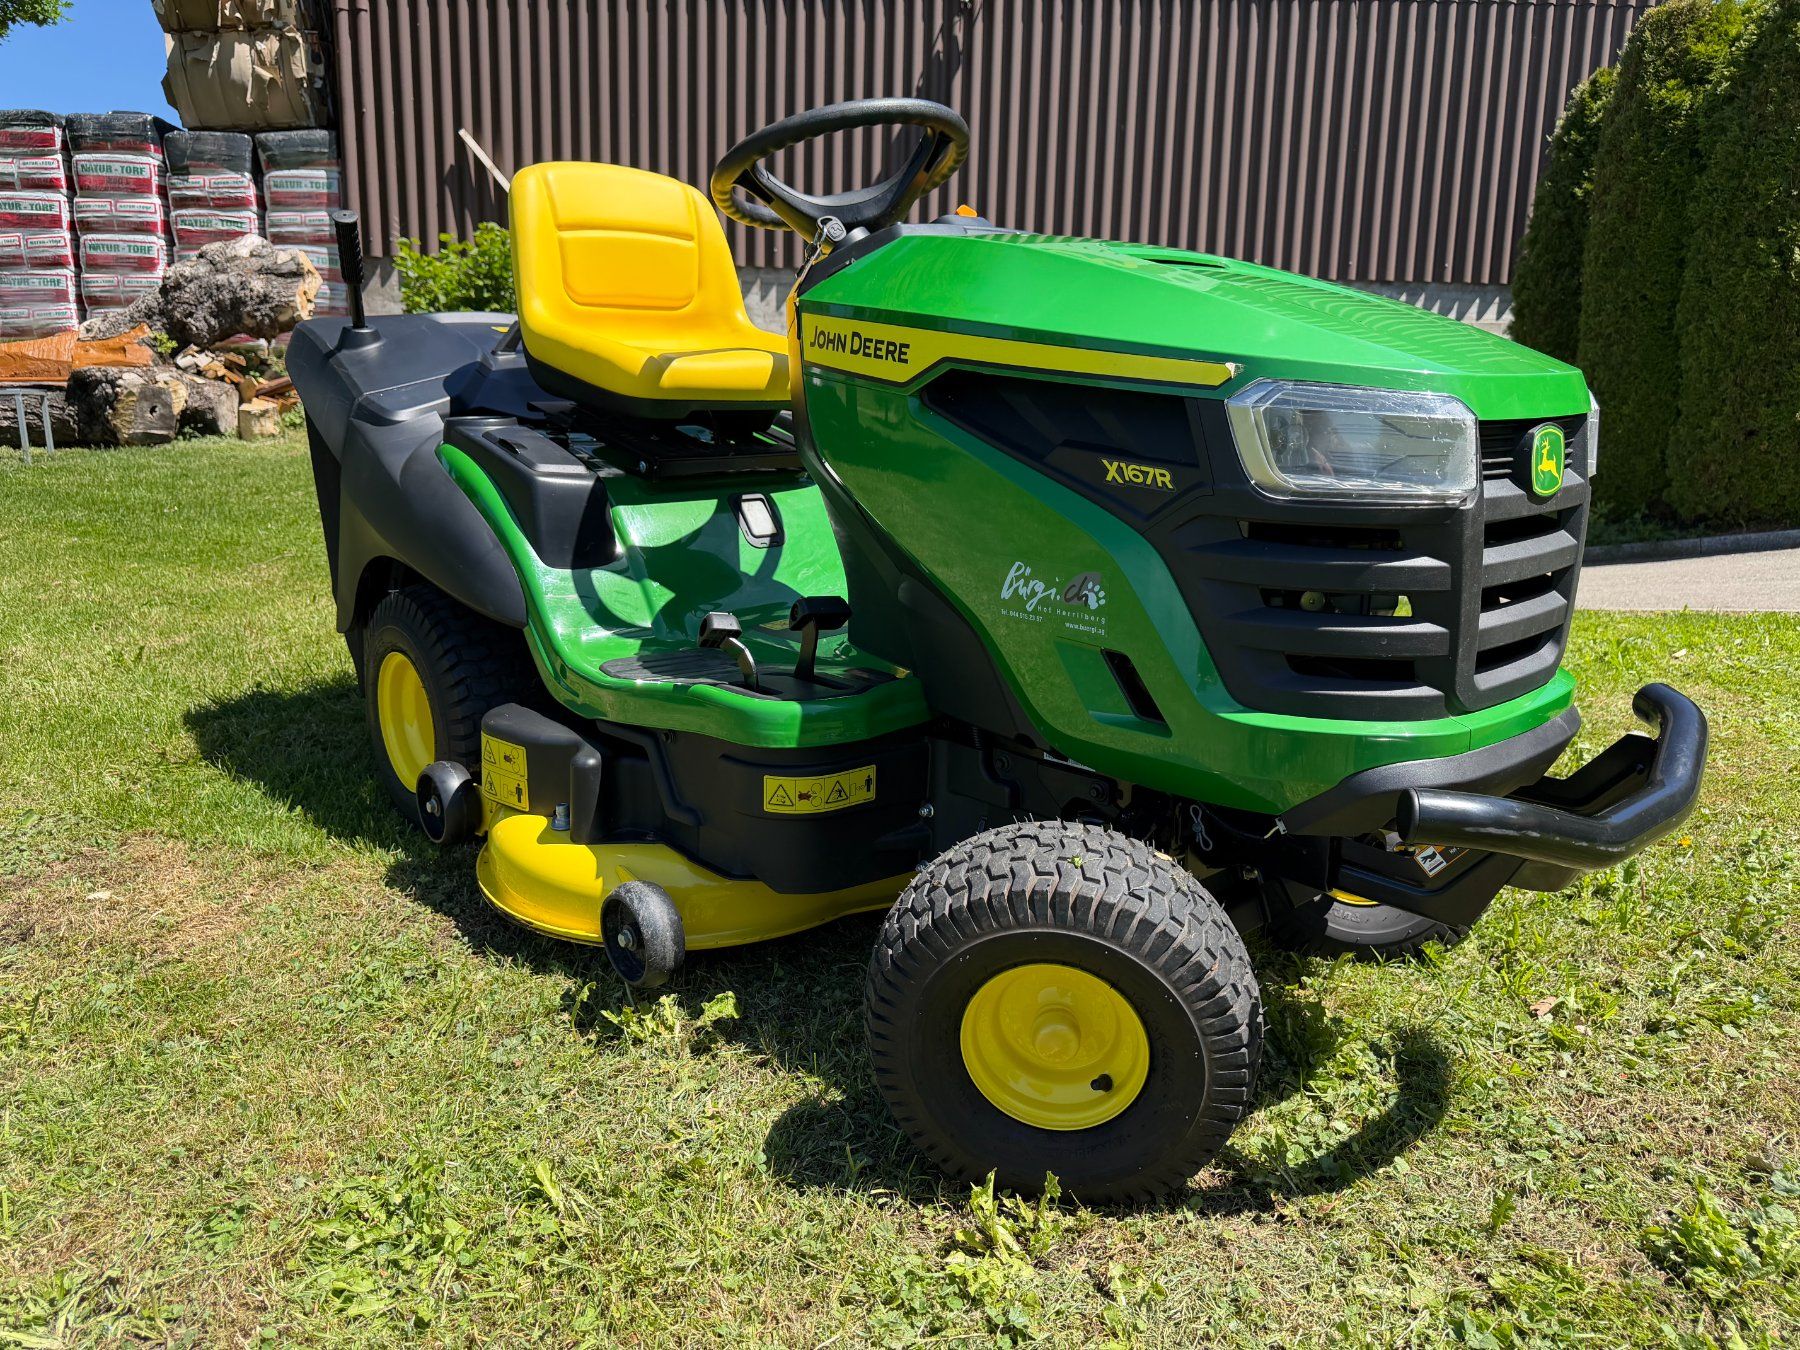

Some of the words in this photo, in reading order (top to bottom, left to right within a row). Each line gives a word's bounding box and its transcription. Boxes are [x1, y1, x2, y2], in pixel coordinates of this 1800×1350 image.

[809, 325, 847, 354] JOHN
[849, 331, 911, 365] DEERE
[1101, 459, 1174, 489] X167R
